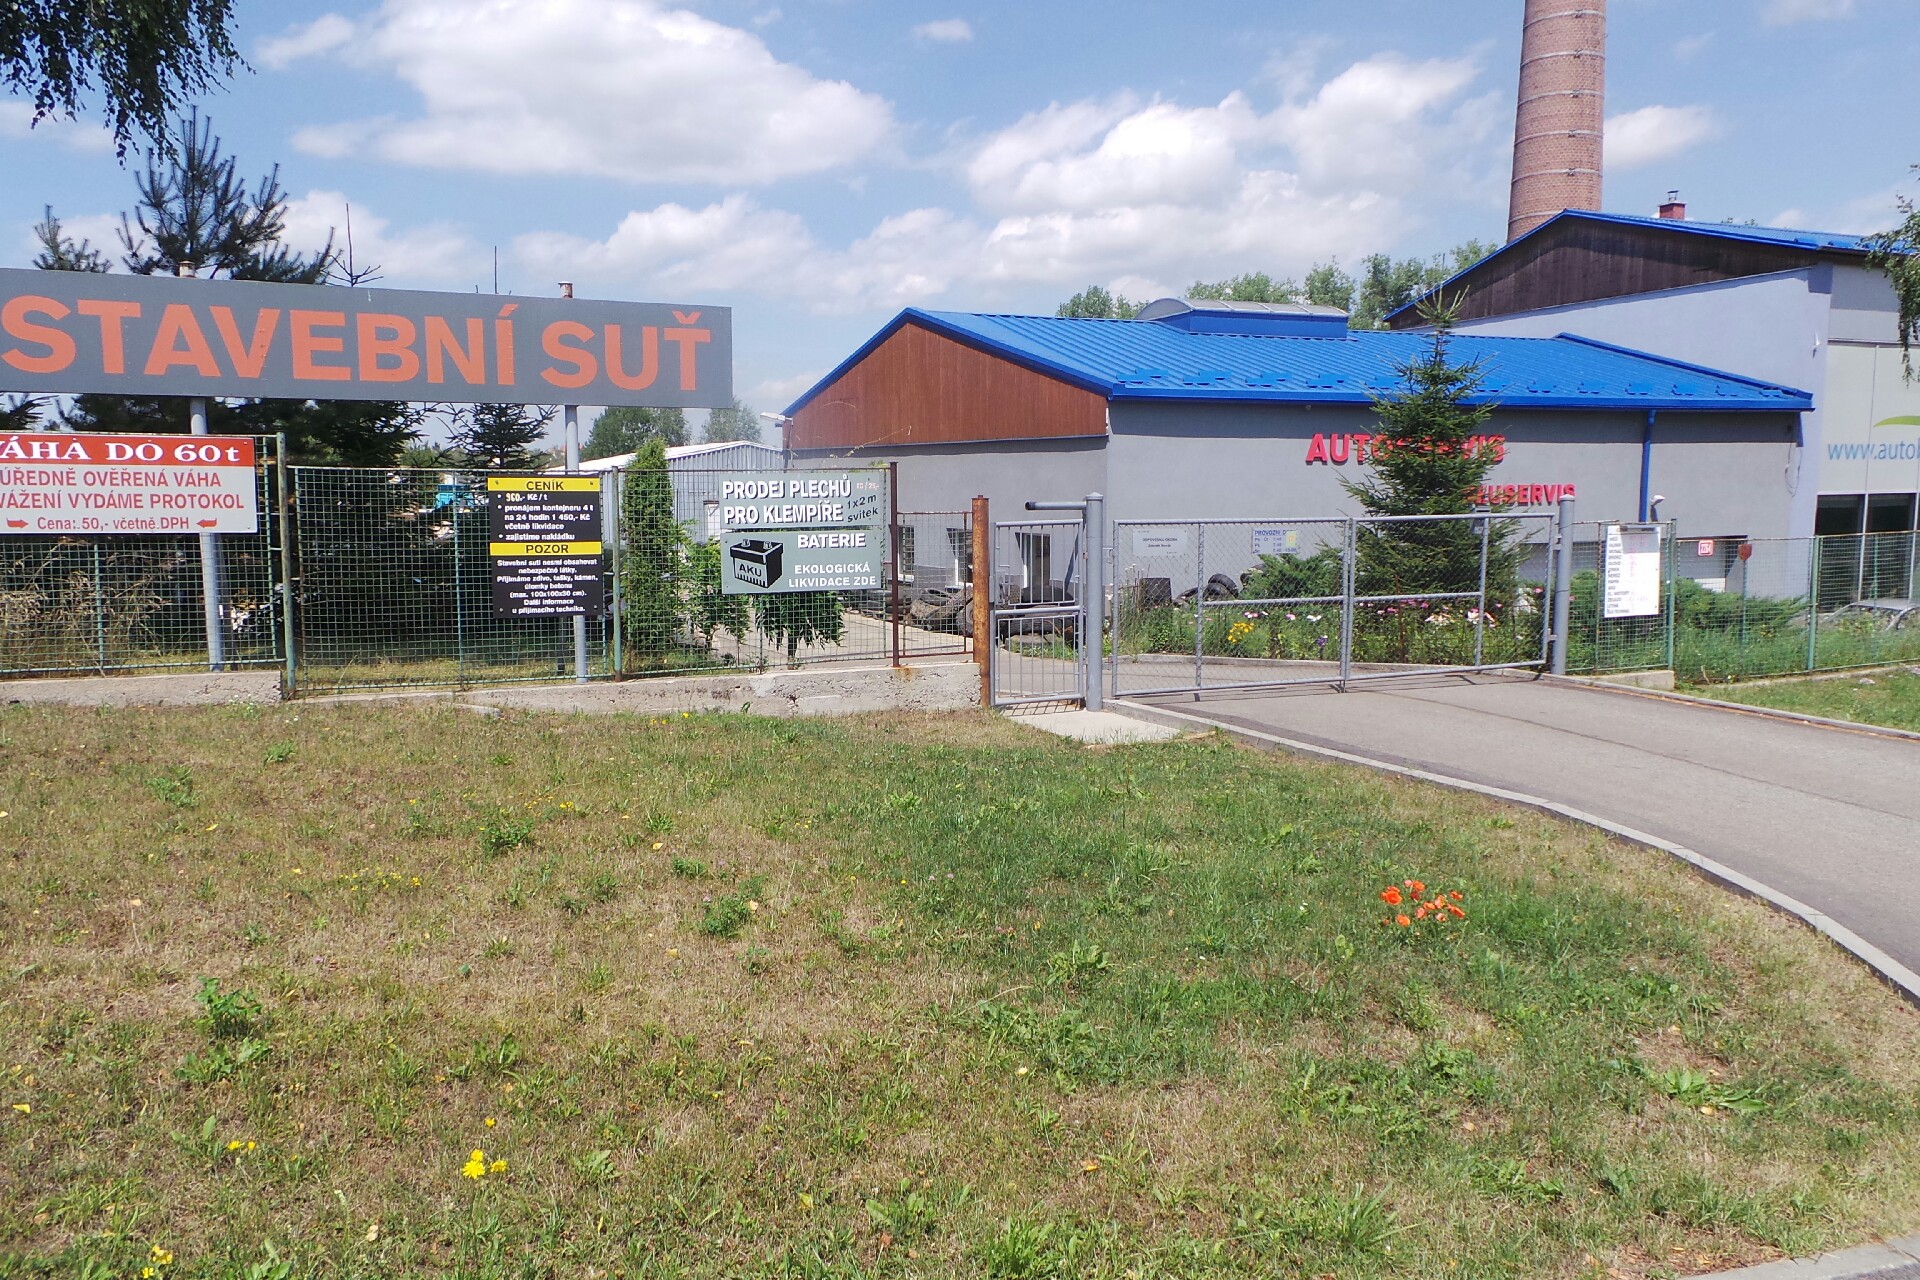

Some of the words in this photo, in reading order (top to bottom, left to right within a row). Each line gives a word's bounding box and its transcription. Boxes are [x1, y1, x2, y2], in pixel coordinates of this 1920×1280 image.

[1, 295, 519, 386] STAVEBNÍ
[540, 311, 711, 391] SUŤ
[106, 441, 164, 462] DO
[0, 467, 77, 487] ÚŘEDNĚ
[83, 468, 169, 487] OVĚŘENÁ
[173, 469, 222, 487] VÁHA
[526, 479, 564, 490] CENÍK
[722, 480, 786, 499] PRODEJ
[789, 474, 851, 498] PLECHŮ
[68, 490, 144, 509] VYDÁME
[150, 493, 244, 509] PROTOKOL
[542, 505, 581, 513] kontejneru
[724, 506, 760, 524] PRO
[763, 500, 844, 523] KLEMPÍŘE
[82, 517, 109, 531] 50,-
[113, 516, 155, 530] včetně
[160, 517, 189, 530] DPH
[797, 533, 867, 549] BATERIE
[526, 545, 569, 554] POZOR
[739, 563, 763, 578] AKU
[794, 561, 870, 575] EKOLOGICKÁ
[788, 577, 851, 588] LIKVIDACE
[853, 575, 877, 586] ZDE
